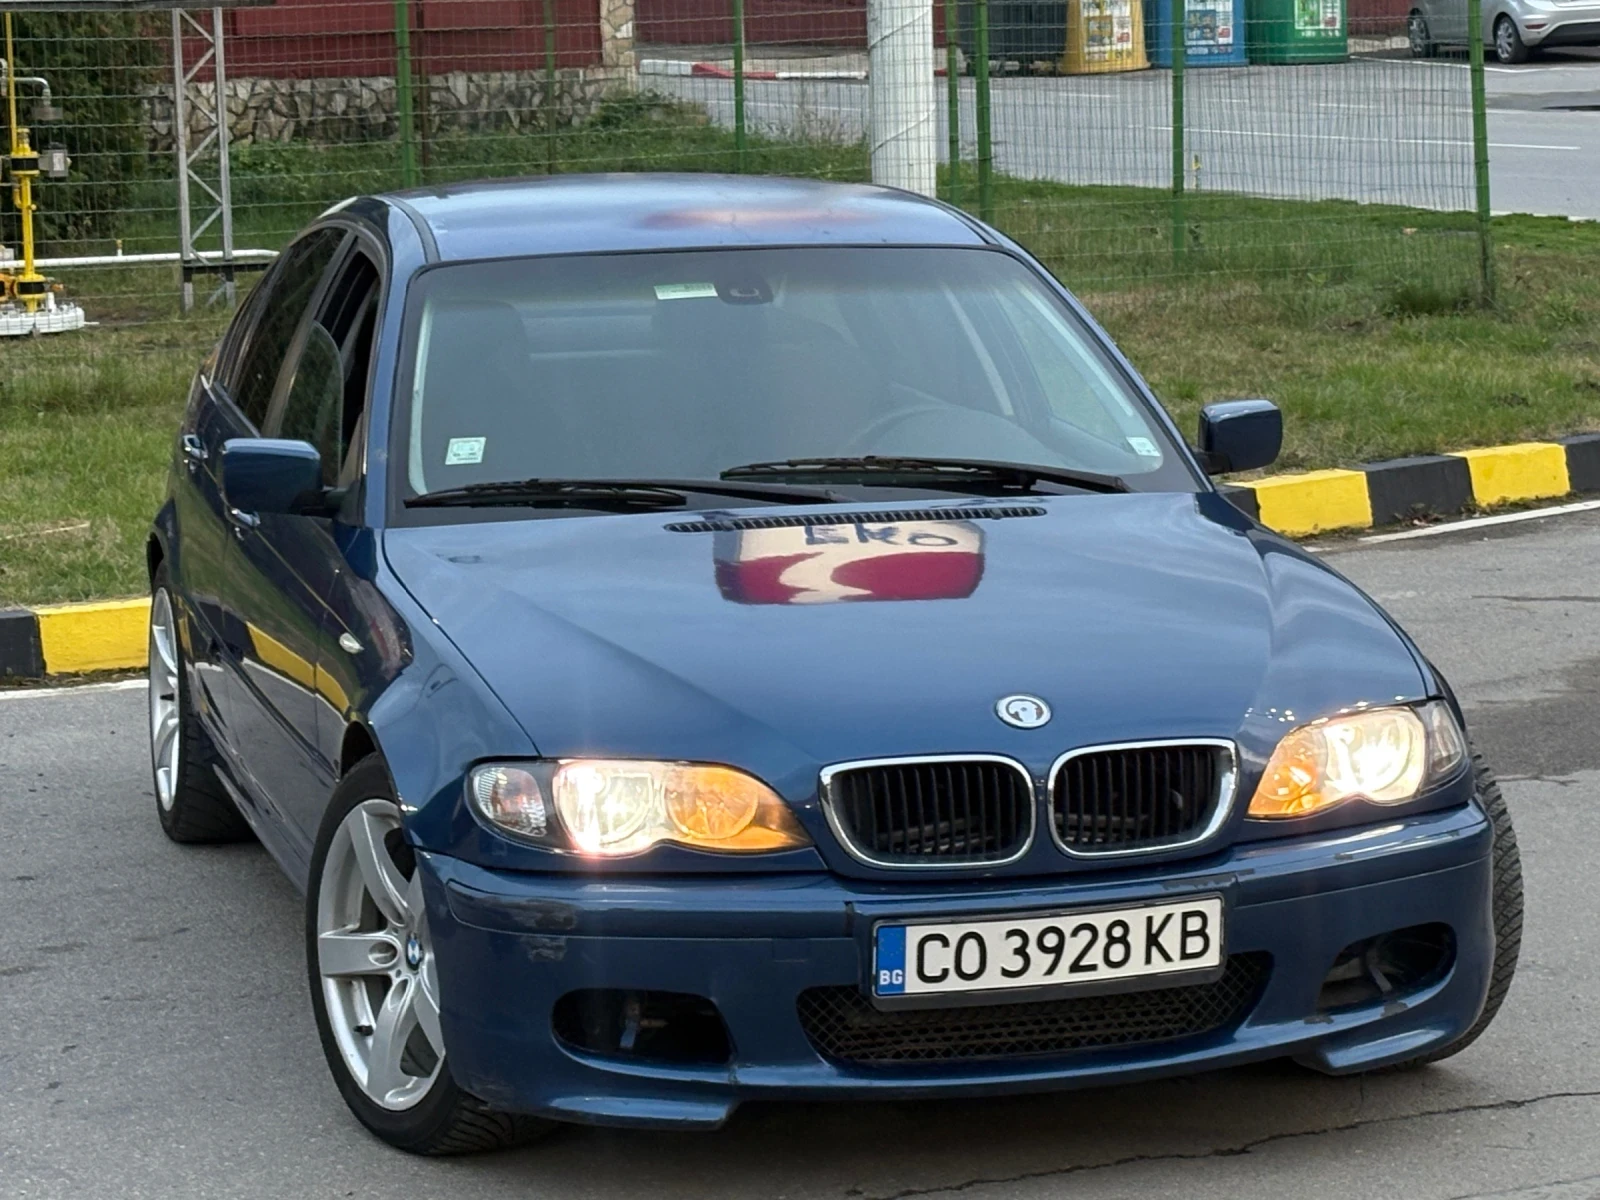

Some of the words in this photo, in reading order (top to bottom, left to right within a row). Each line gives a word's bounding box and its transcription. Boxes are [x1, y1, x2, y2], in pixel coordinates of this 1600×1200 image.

[1000, 919, 1132, 979] 3928
[1144, 909, 1211, 967] KB
[879, 970, 904, 986] BG
